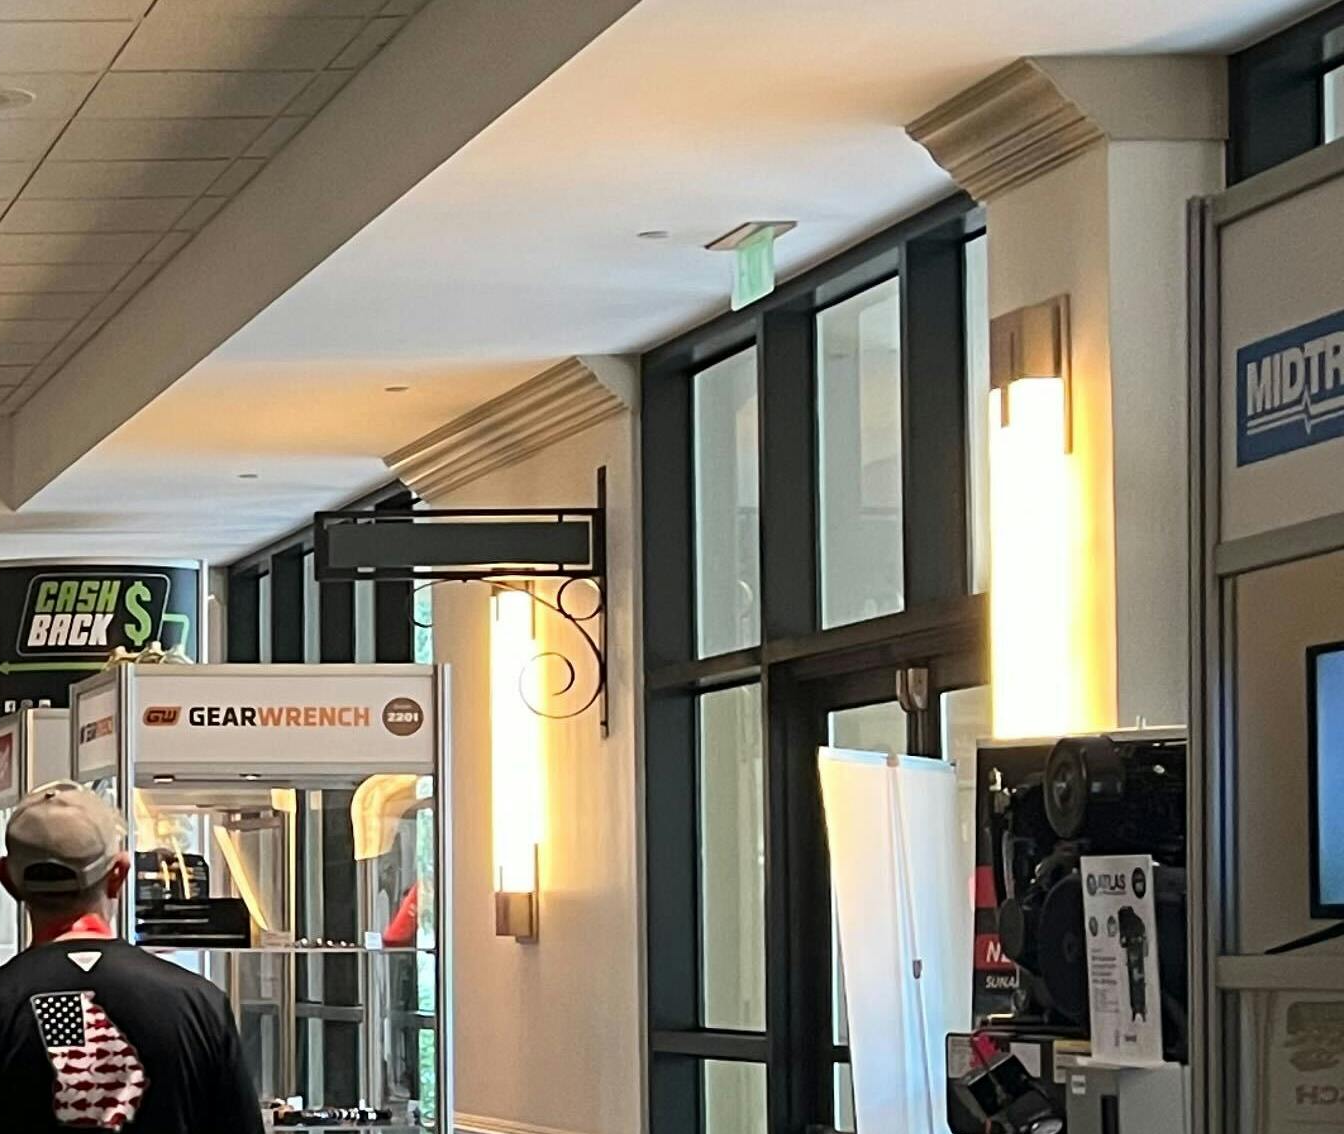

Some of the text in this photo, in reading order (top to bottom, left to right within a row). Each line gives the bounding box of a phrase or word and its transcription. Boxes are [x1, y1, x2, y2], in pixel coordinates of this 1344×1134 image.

[1247, 332, 1344, 416] MIDTR
[34, 580, 121, 613] CASH
[27, 613, 114, 647] BACK
[189, 706, 370, 727] GEARWRENCH
